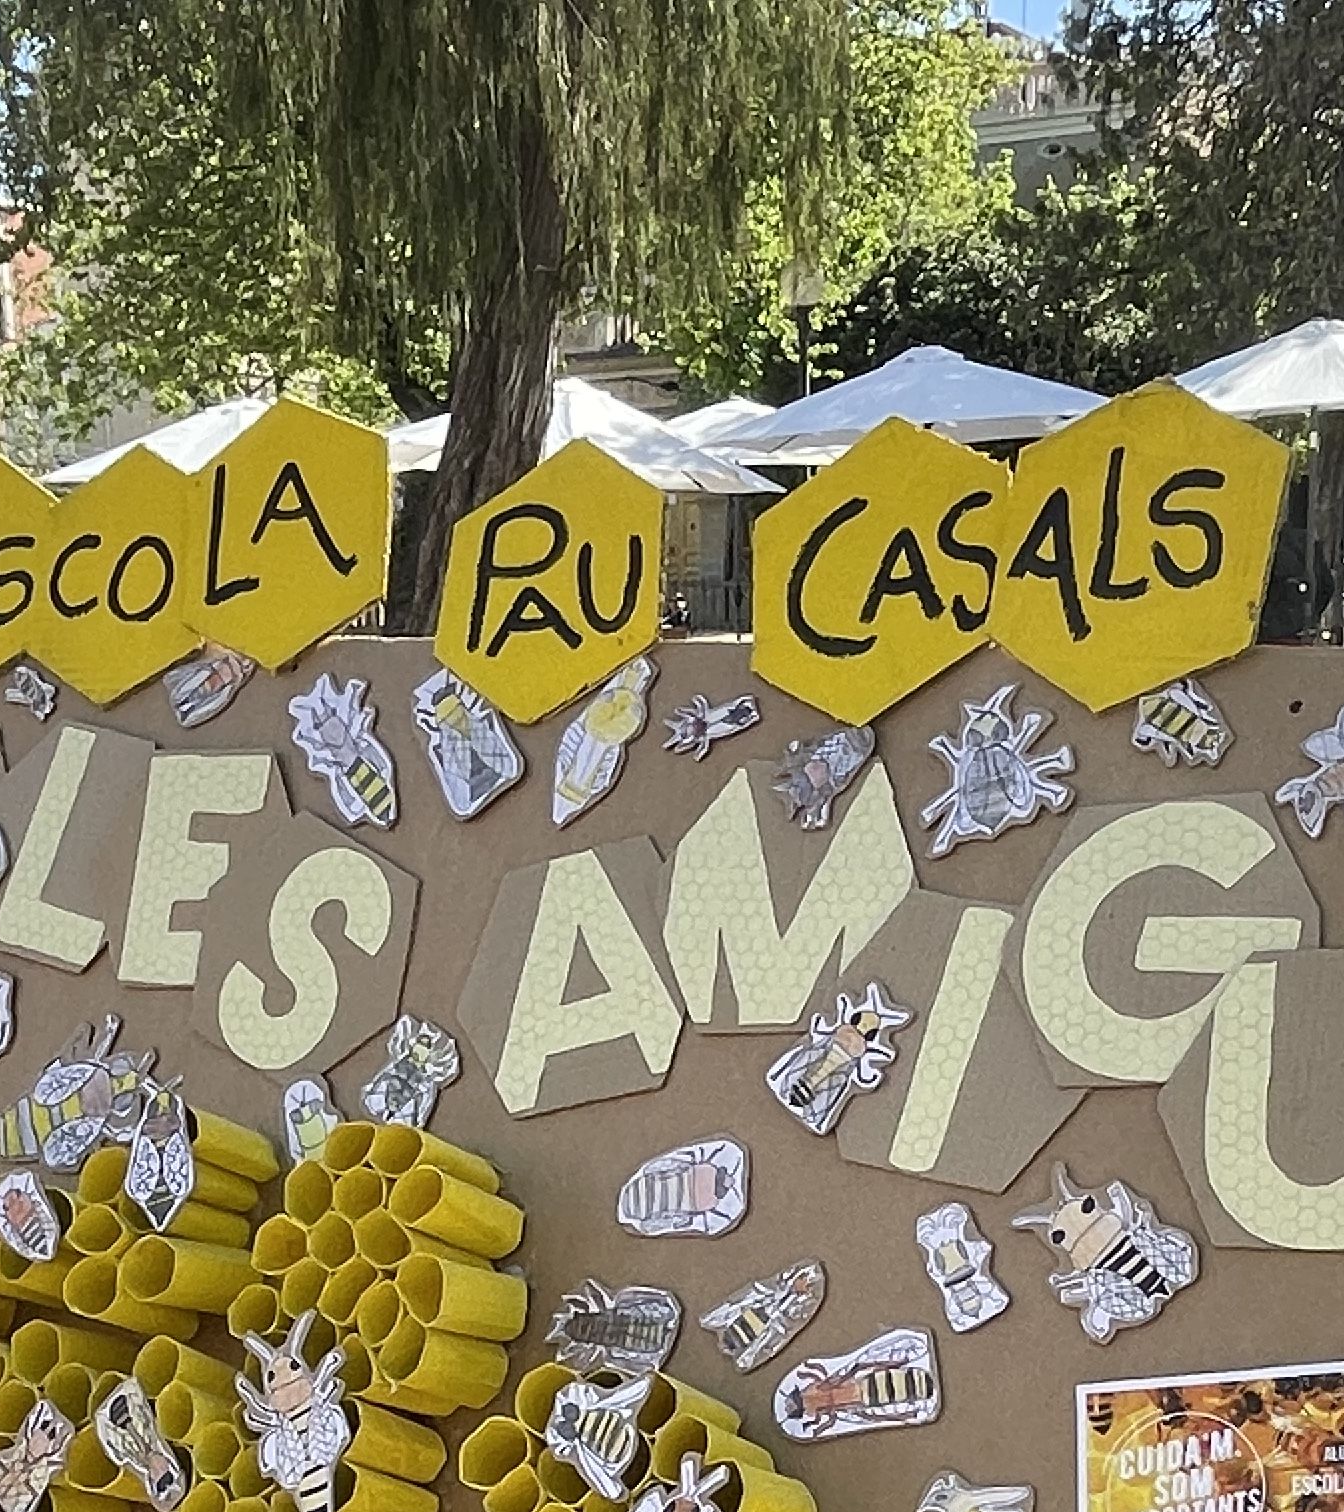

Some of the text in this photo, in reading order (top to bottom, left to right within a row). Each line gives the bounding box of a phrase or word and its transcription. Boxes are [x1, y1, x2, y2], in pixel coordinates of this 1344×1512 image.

[467, 503, 643, 658] PAU
[787, 446, 1227, 659] CASALS
[1154, 1466, 1214, 1505] SOM
